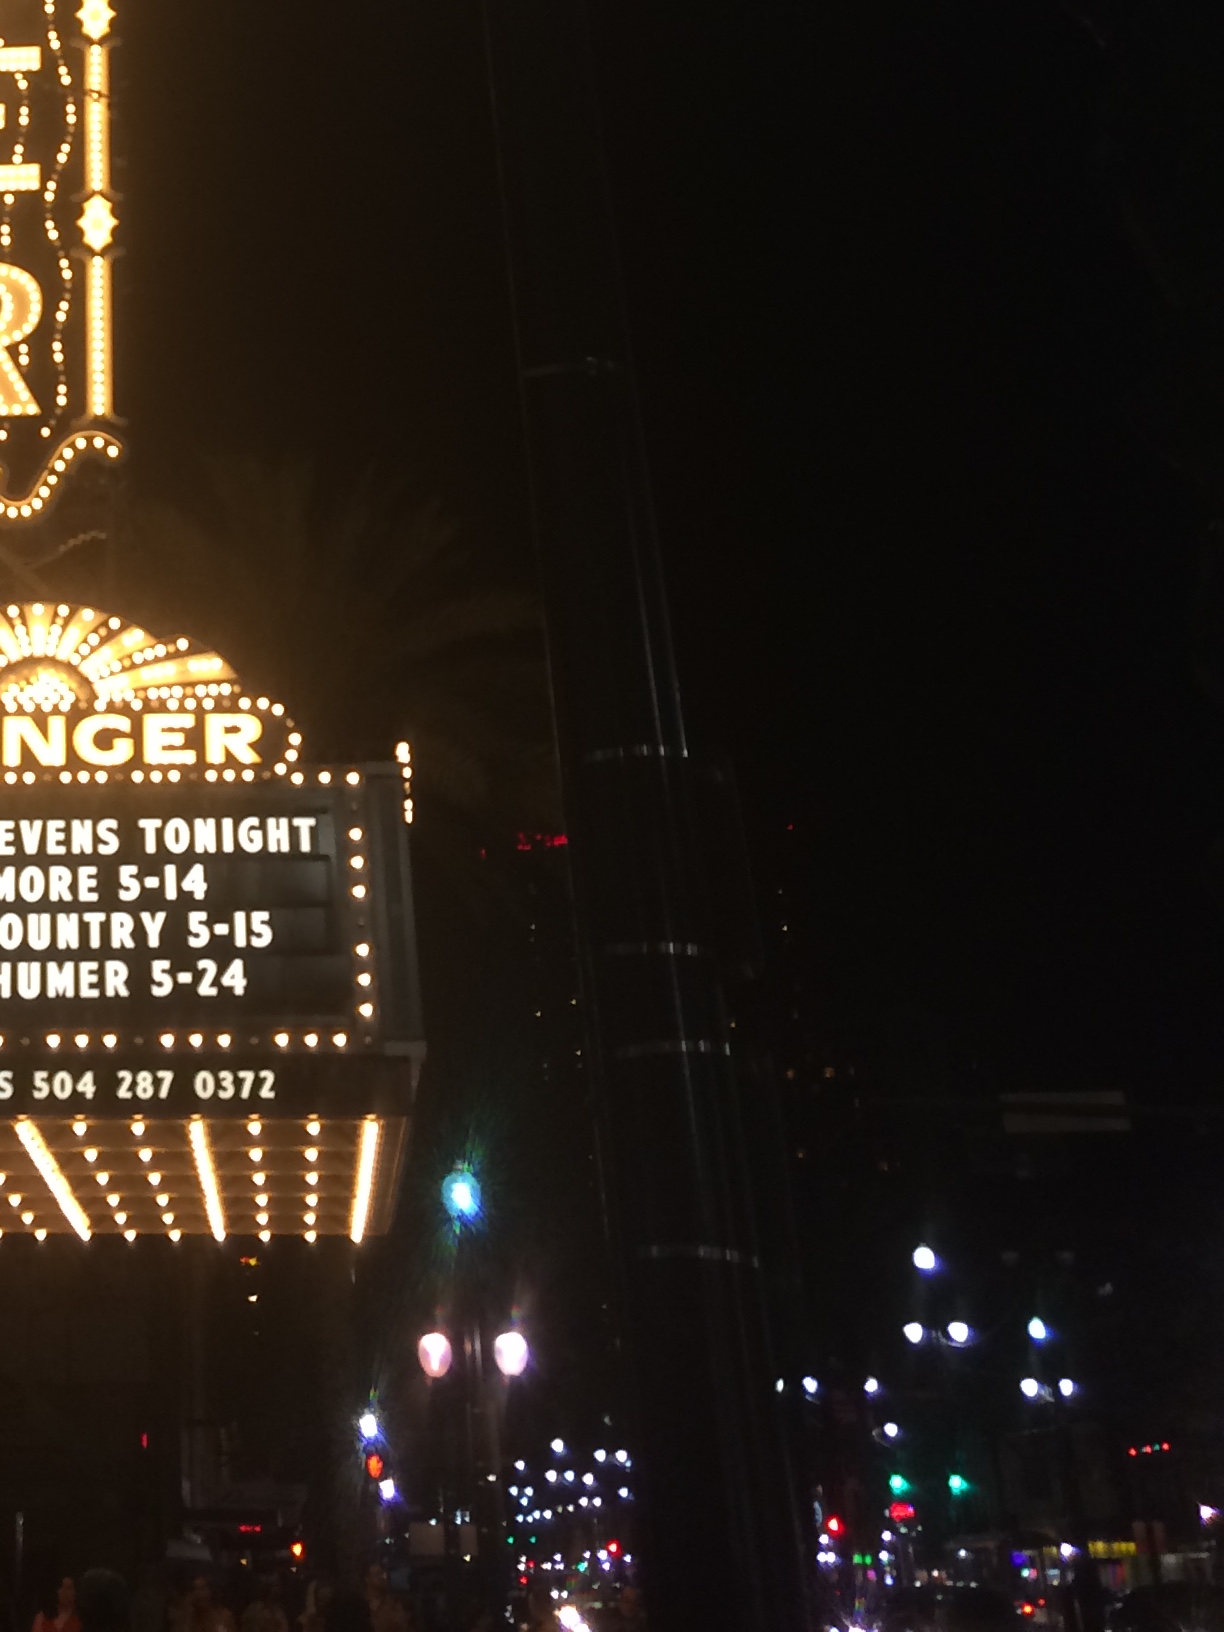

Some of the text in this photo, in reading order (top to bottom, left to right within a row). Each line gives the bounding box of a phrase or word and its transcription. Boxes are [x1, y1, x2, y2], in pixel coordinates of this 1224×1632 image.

[137, 817, 316, 854] TONIGHT
[118, 863, 207, 901] 5-14
[188, 911, 272, 948] 5-15
[151, 959, 247, 997] 5-24
[33, 1071, 96, 1099] 504
[117, 1070, 174, 1099] 287
[194, 1070, 275, 1099] 0372
